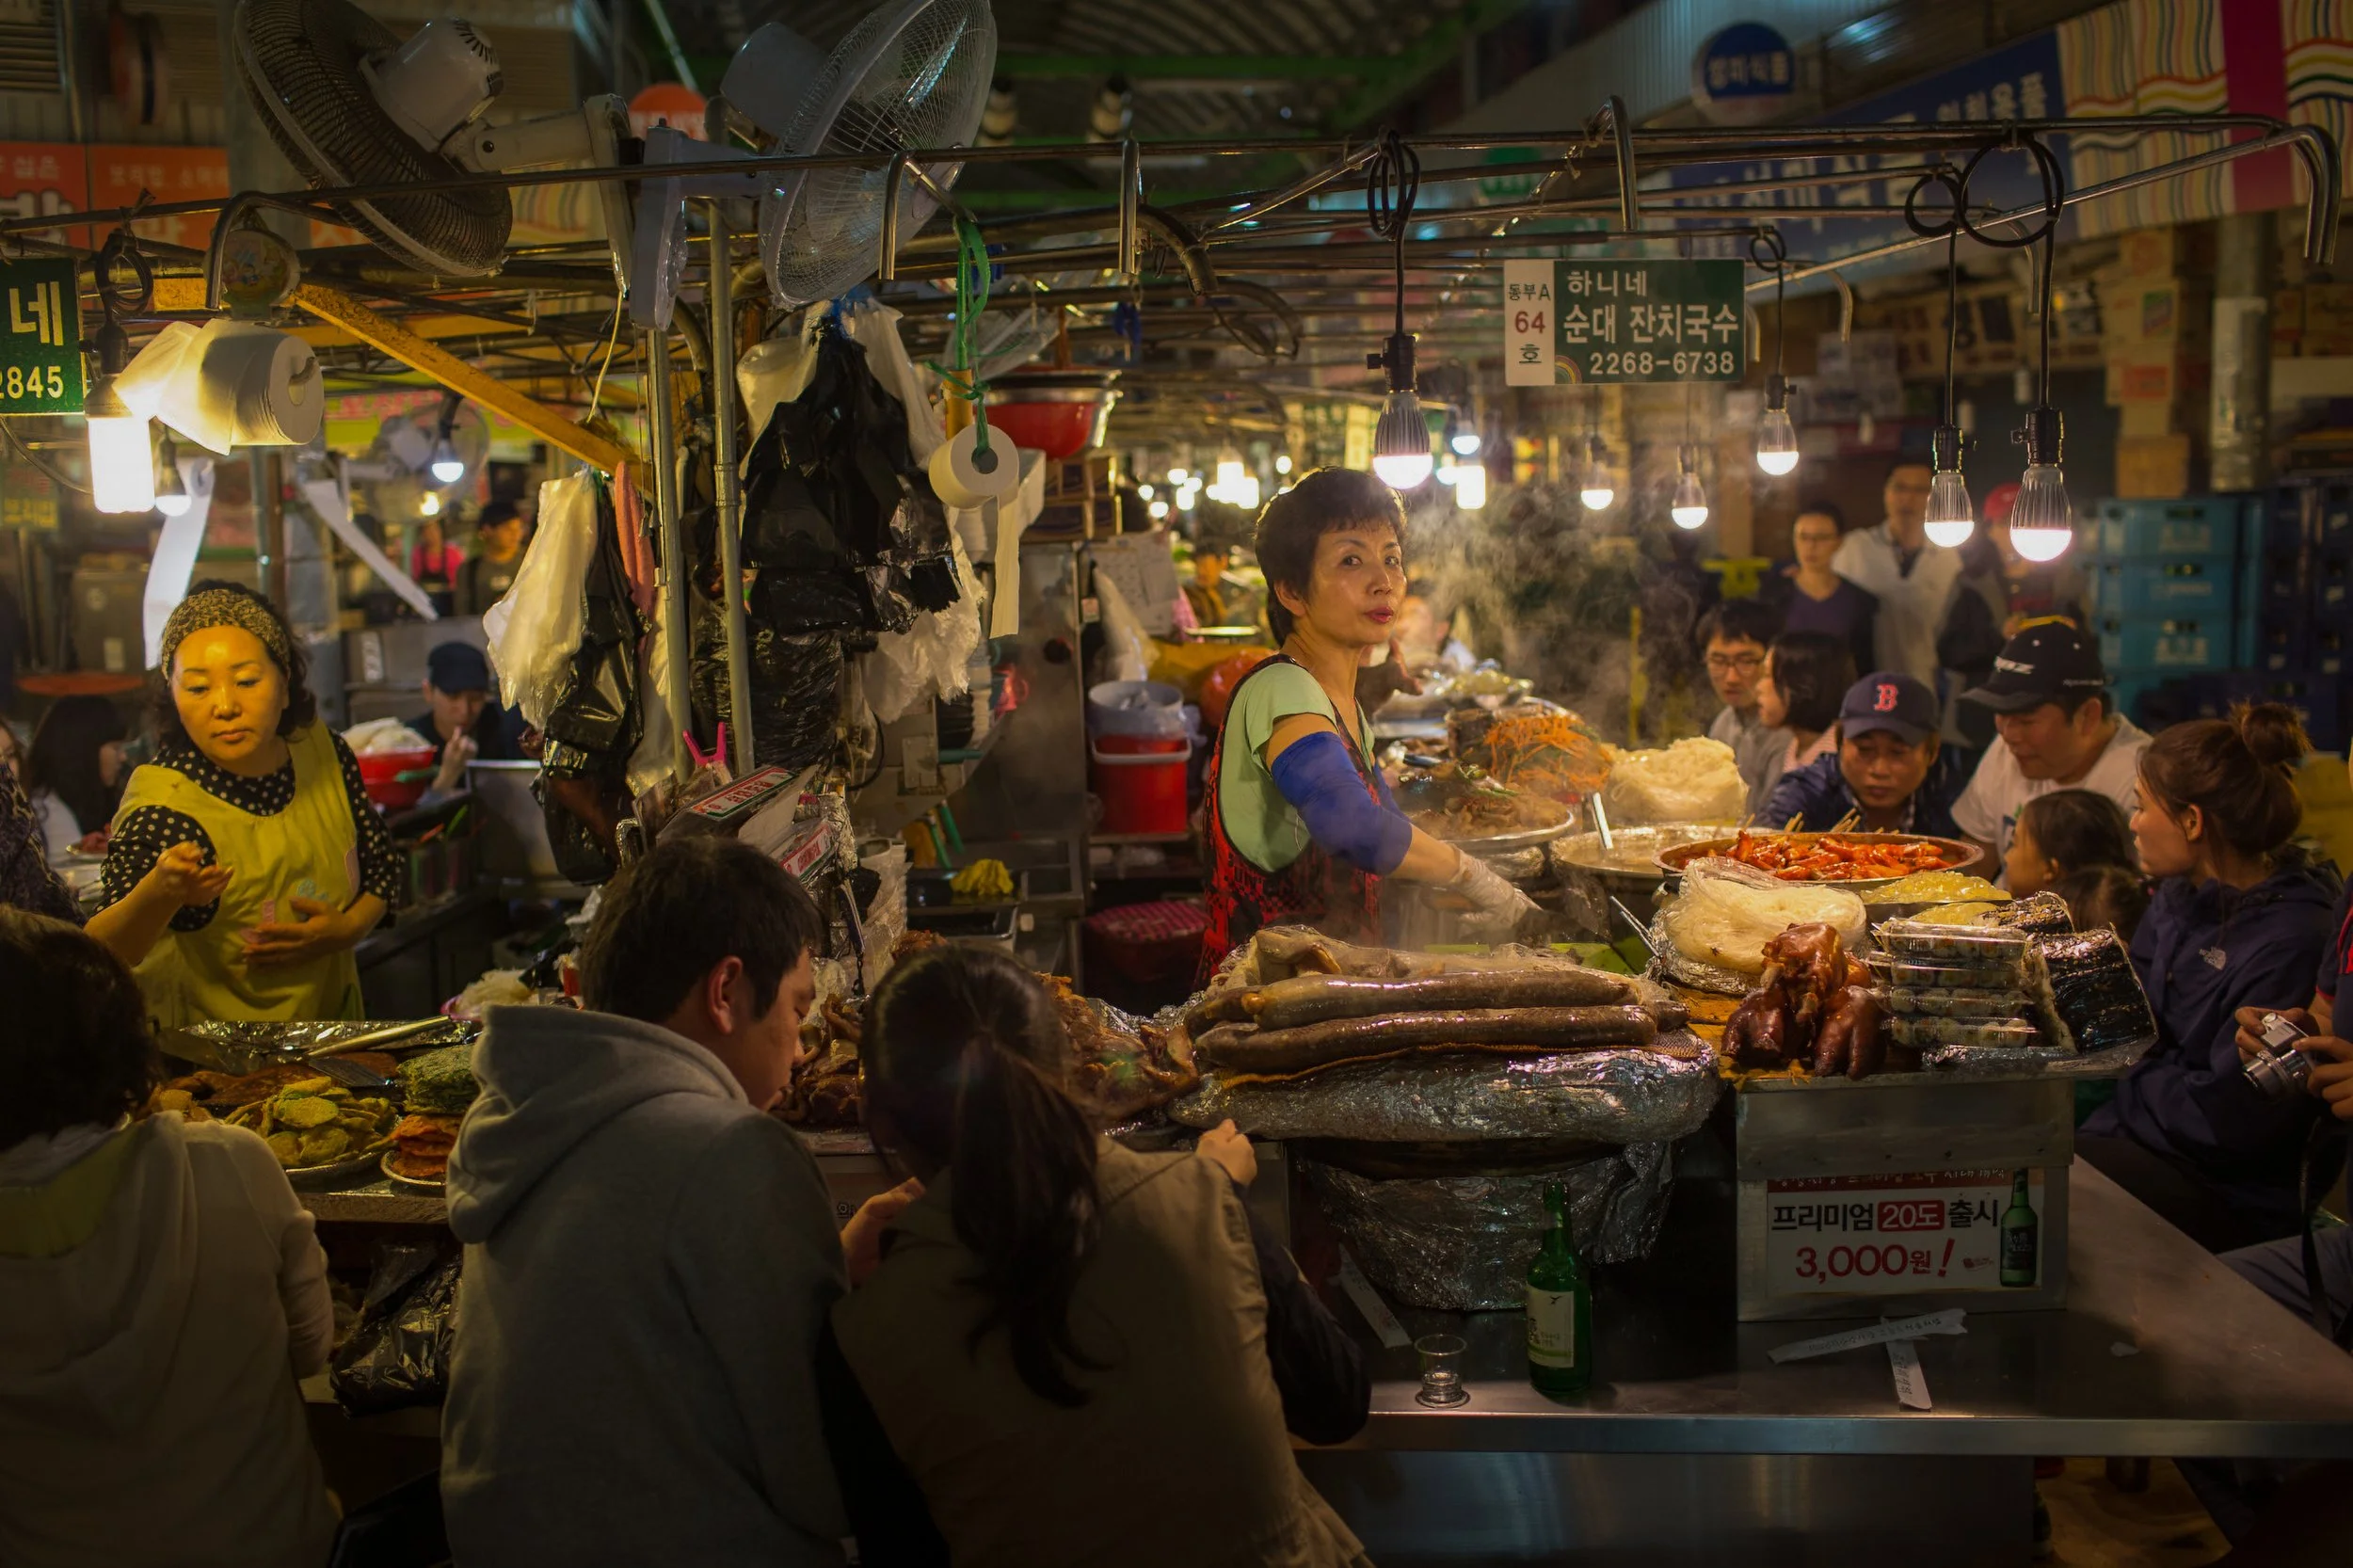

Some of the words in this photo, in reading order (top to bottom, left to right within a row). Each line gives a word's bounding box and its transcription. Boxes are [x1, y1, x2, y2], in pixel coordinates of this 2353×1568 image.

[1508, 283, 1551, 301] 동부A
[1567, 271, 1647, 297] 하니네
[8, 280, 64, 346] 네
[1514, 310, 1546, 334] 64
[1563, 305, 1616, 344] 순대
[1629, 304, 1739, 344] 잔치국수
[1519, 344, 1542, 364] 호
[1590, 351, 1735, 376] 2268-6738
[0, 365, 64, 400] 845
[1874, 684, 1898, 712] B
[1772, 1202, 1874, 1231] 프리미엄
[1882, 1204, 1941, 1228] 20도
[1948, 1199, 1998, 1227] 출시
[1796, 1238, 1955, 1284] 3,000원!
